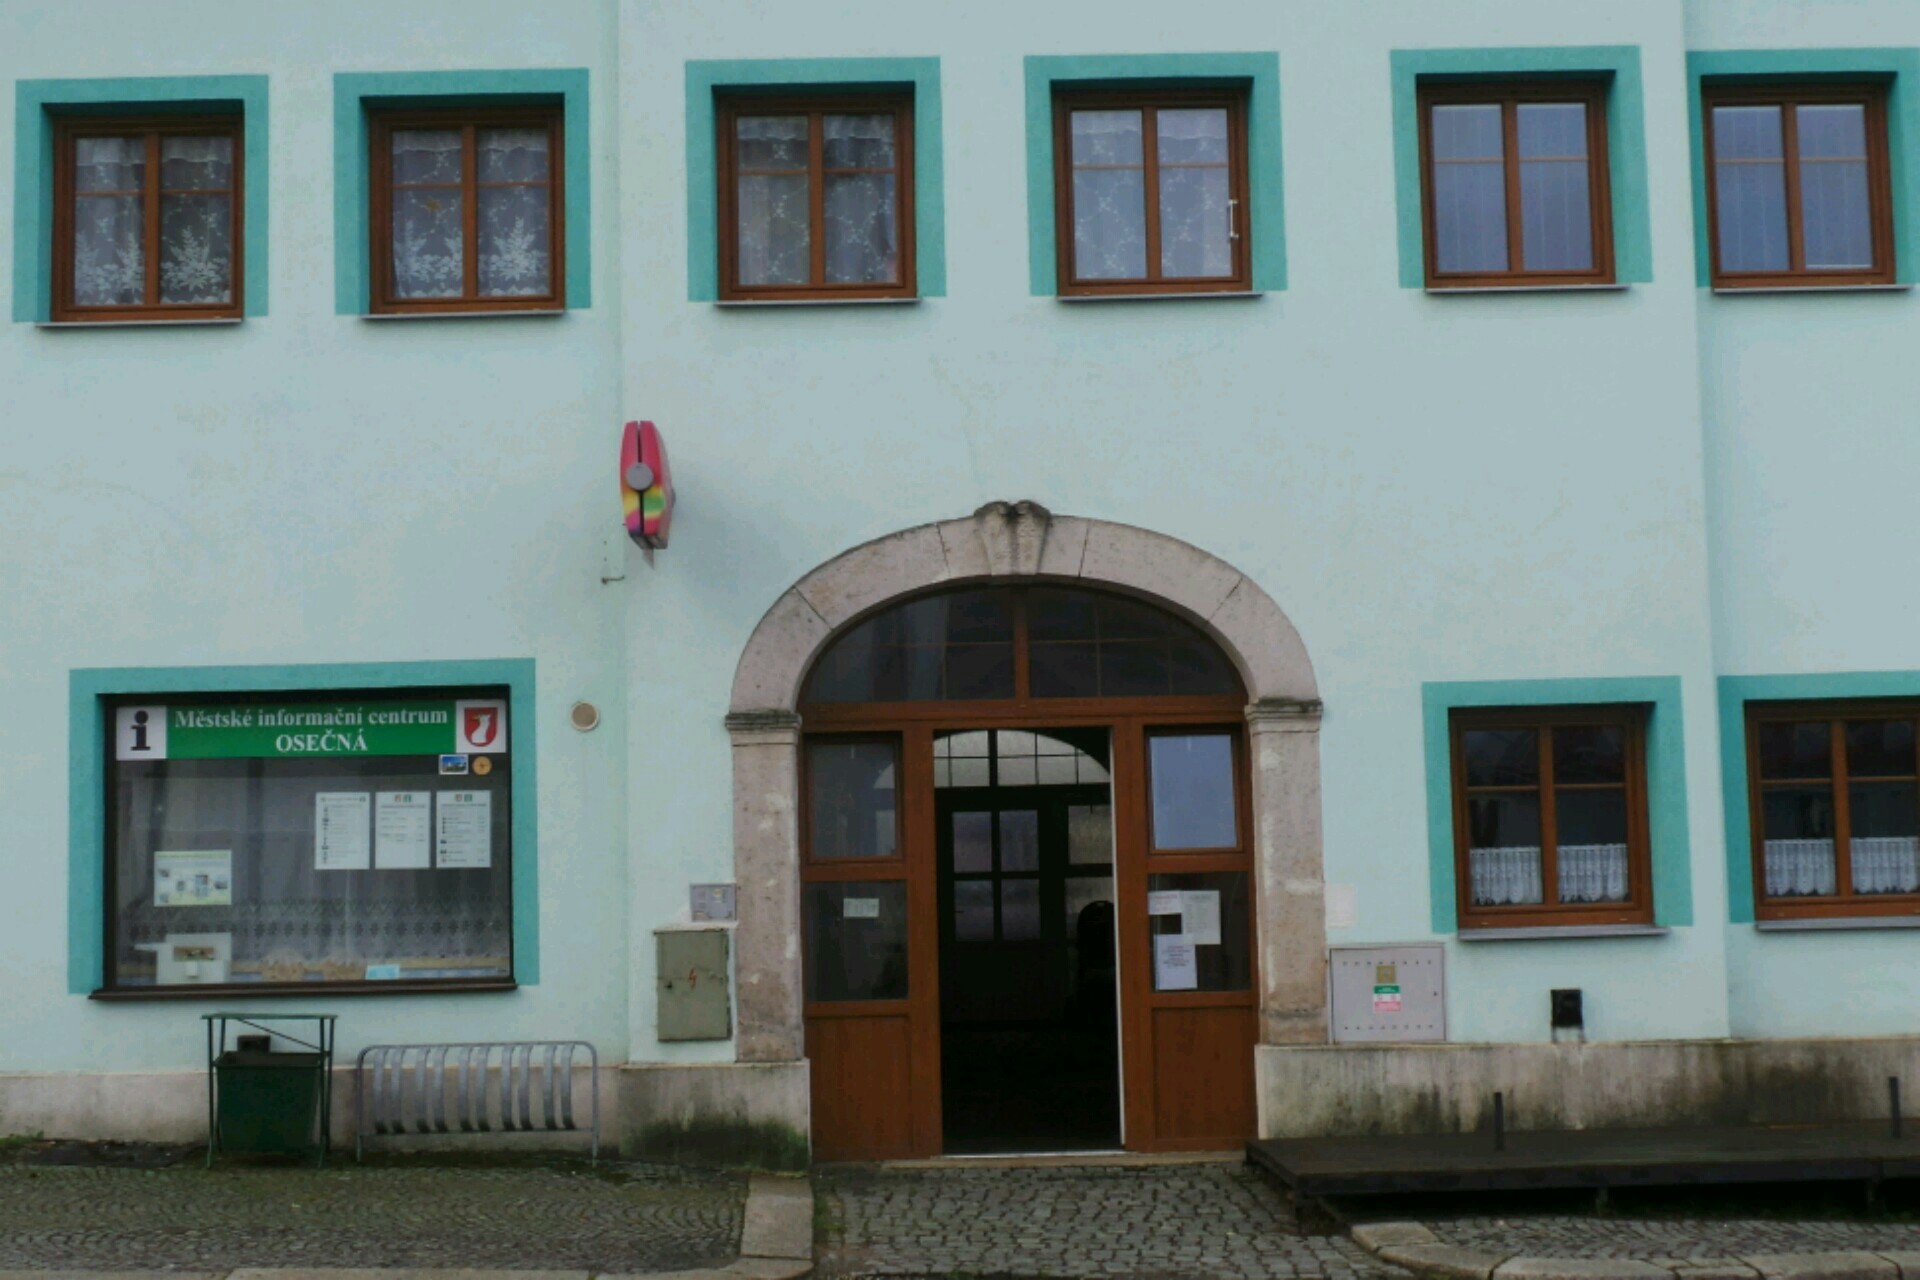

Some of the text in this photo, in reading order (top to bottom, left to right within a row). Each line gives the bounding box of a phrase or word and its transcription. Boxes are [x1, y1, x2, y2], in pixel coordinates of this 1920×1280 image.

[175, 706, 447, 728] Městské informační centrum
[131, 710, 151, 751] i
[275, 728, 368, 753] OSEČNÁ
